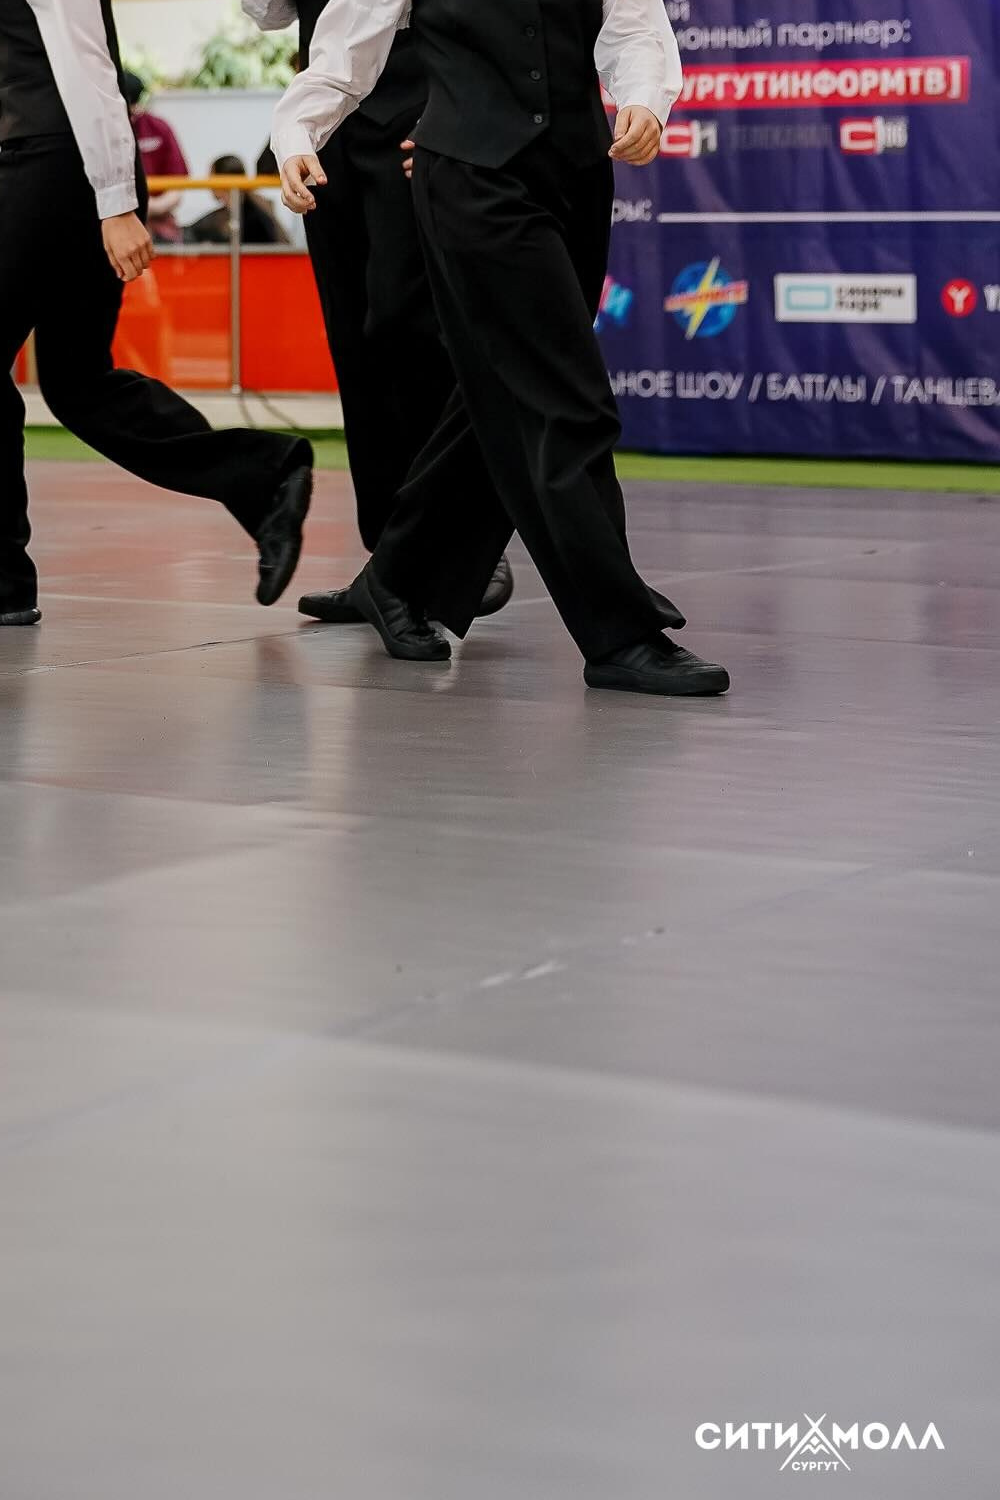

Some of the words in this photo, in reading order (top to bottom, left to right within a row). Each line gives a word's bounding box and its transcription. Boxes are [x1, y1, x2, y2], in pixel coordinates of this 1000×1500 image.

[677, 18, 773, 52] онный
[682, 59, 963, 102] УРГУТИНФОРМТВ]
[609, 369, 675, 399] НОЕ
[675, 371, 745, 400] ШОУ
[890, 375, 1000, 407] ТАНЦЕВ
